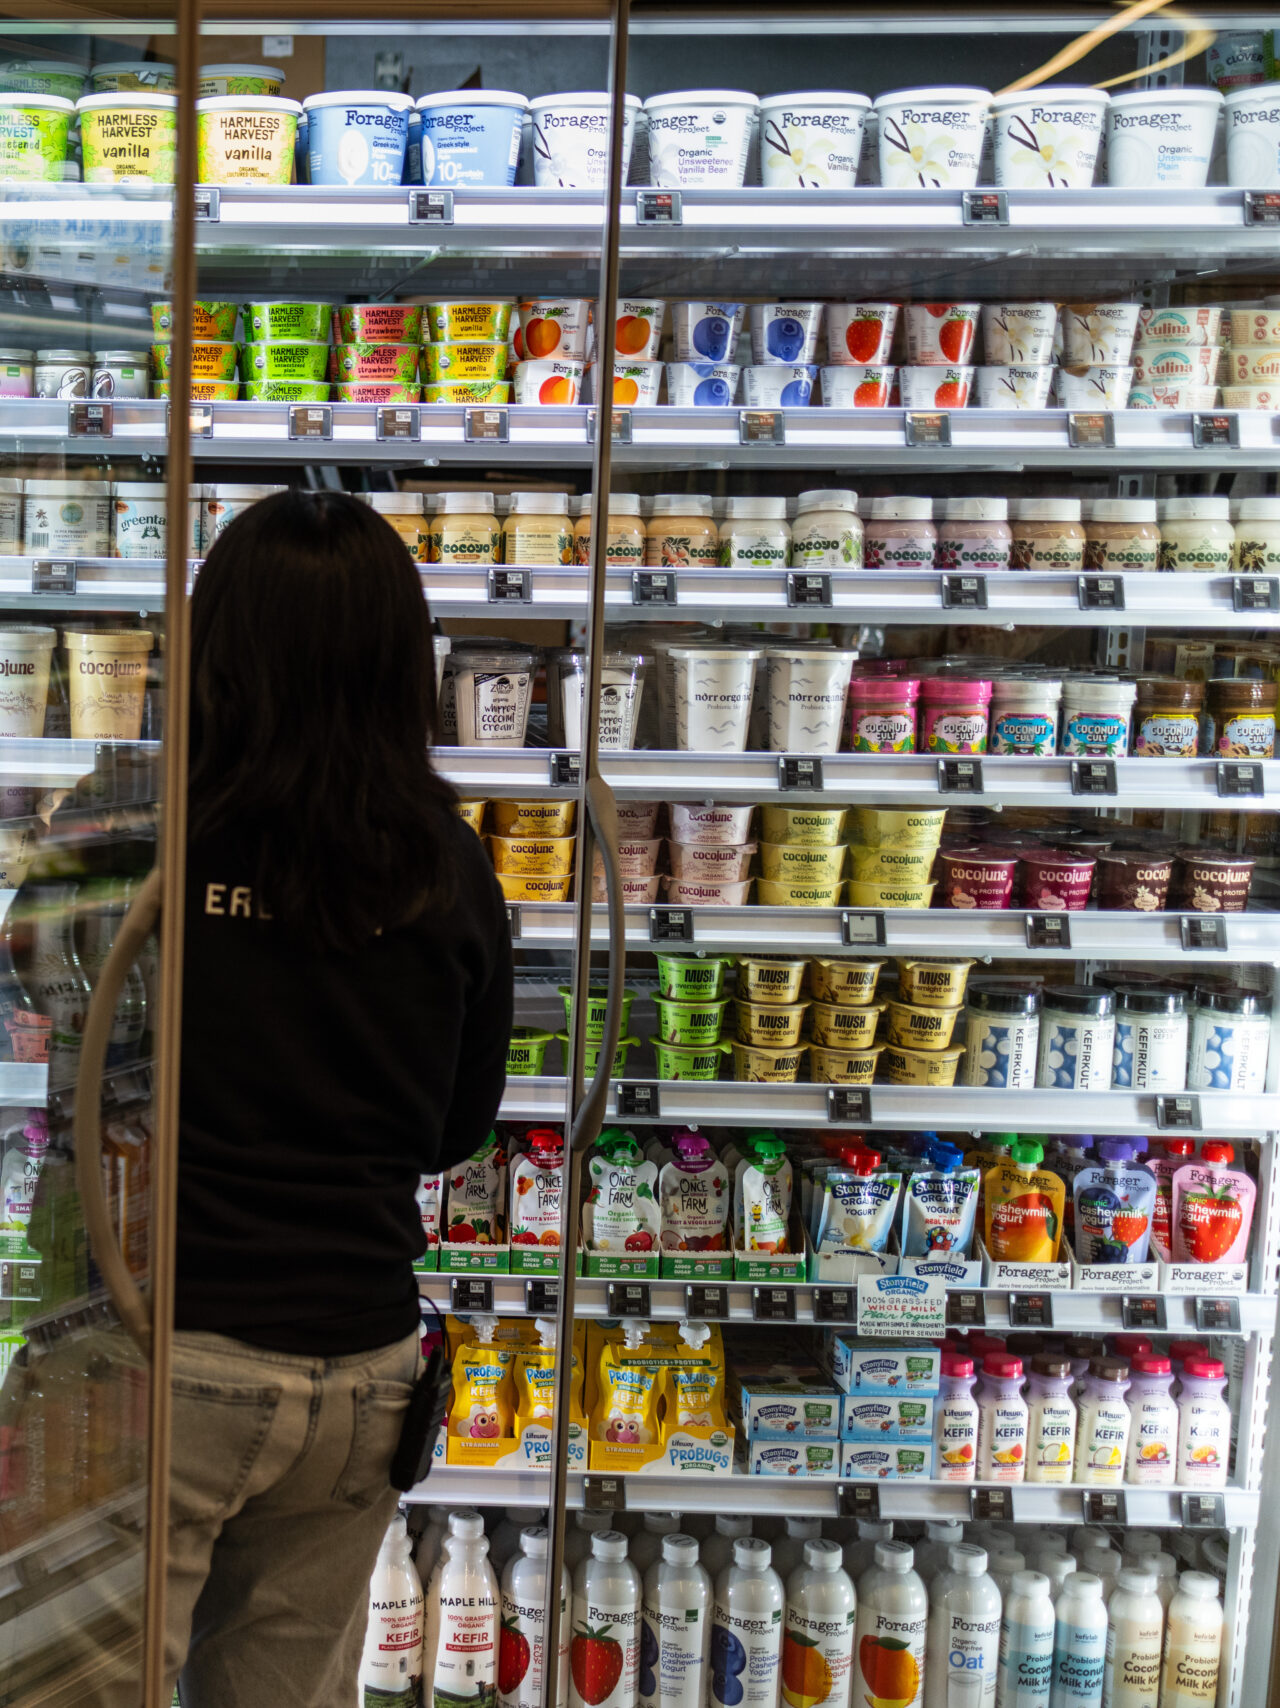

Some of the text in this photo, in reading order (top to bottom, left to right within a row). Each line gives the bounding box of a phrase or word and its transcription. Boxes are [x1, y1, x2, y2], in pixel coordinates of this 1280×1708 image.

[1226, 52, 1263, 66] CLOVER
[98, 114, 158, 127] HARMLESS
[345, 110, 404, 130] Forager
[781, 113, 850, 129] Forager
[102, 126, 154, 139] HARVEST
[103, 142, 151, 159] vanilla
[1000, 307, 1040, 319] Forager
[364, 327, 404, 337] strawberry
[1145, 325, 1190, 336] culina
[484, 702, 516, 714] whipped
[482, 713, 515, 724] coconut
[482, 723, 515, 733] cream
[1004, 725, 1047, 735] COCONUT
[1015, 734, 1035, 742] CULT
[783, 852, 828, 864] cocojune
[951, 868, 1008, 882] cocojune
[758, 1014, 790, 1029] MUSH
[749, 1028, 782, 1037] overnight
[1134, 1027, 1148, 1089] KEFIRKULT
[609, 1171, 637, 1188] ONCE
[1001, 1171, 1051, 1187] Forager
[833, 1183, 891, 1197] Stonyfield
[608, 1188, 634, 1207] FARM
[841, 1197, 882, 1208] ORGANIC
[845, 1208, 877, 1217] YOGURT
[1081, 1204, 1143, 1218] cashewmilk
[1081, 1213, 1113, 1227] yogurt
[997, 1265, 1053, 1279] Forager
[879, 1277, 925, 1292] Stonyfield
[885, 1289, 919, 1298] ORGANIC
[862, 1296, 942, 1306] 100% GRASS-FED
[868, 1304, 937, 1313] WHOLE MILK
[862, 1311, 944, 1322] Plain Yogurt
[874, 1328, 902, 1336] PROTEIN
[627, 1358, 668, 1366] PROBIOTICS
[995, 1427, 1024, 1438] KEFIR
[670, 1439, 694, 1448] Lifeway
[669, 1448, 729, 1469] PROBUGS
[440, 1597, 498, 1607] MAPLE HILL
[458, 1621, 485, 1629] ORGANIC
[453, 1631, 488, 1643] KEFIR
[948, 1650, 985, 1670] Oat
[662, 1663, 686, 1673] Yogurt
